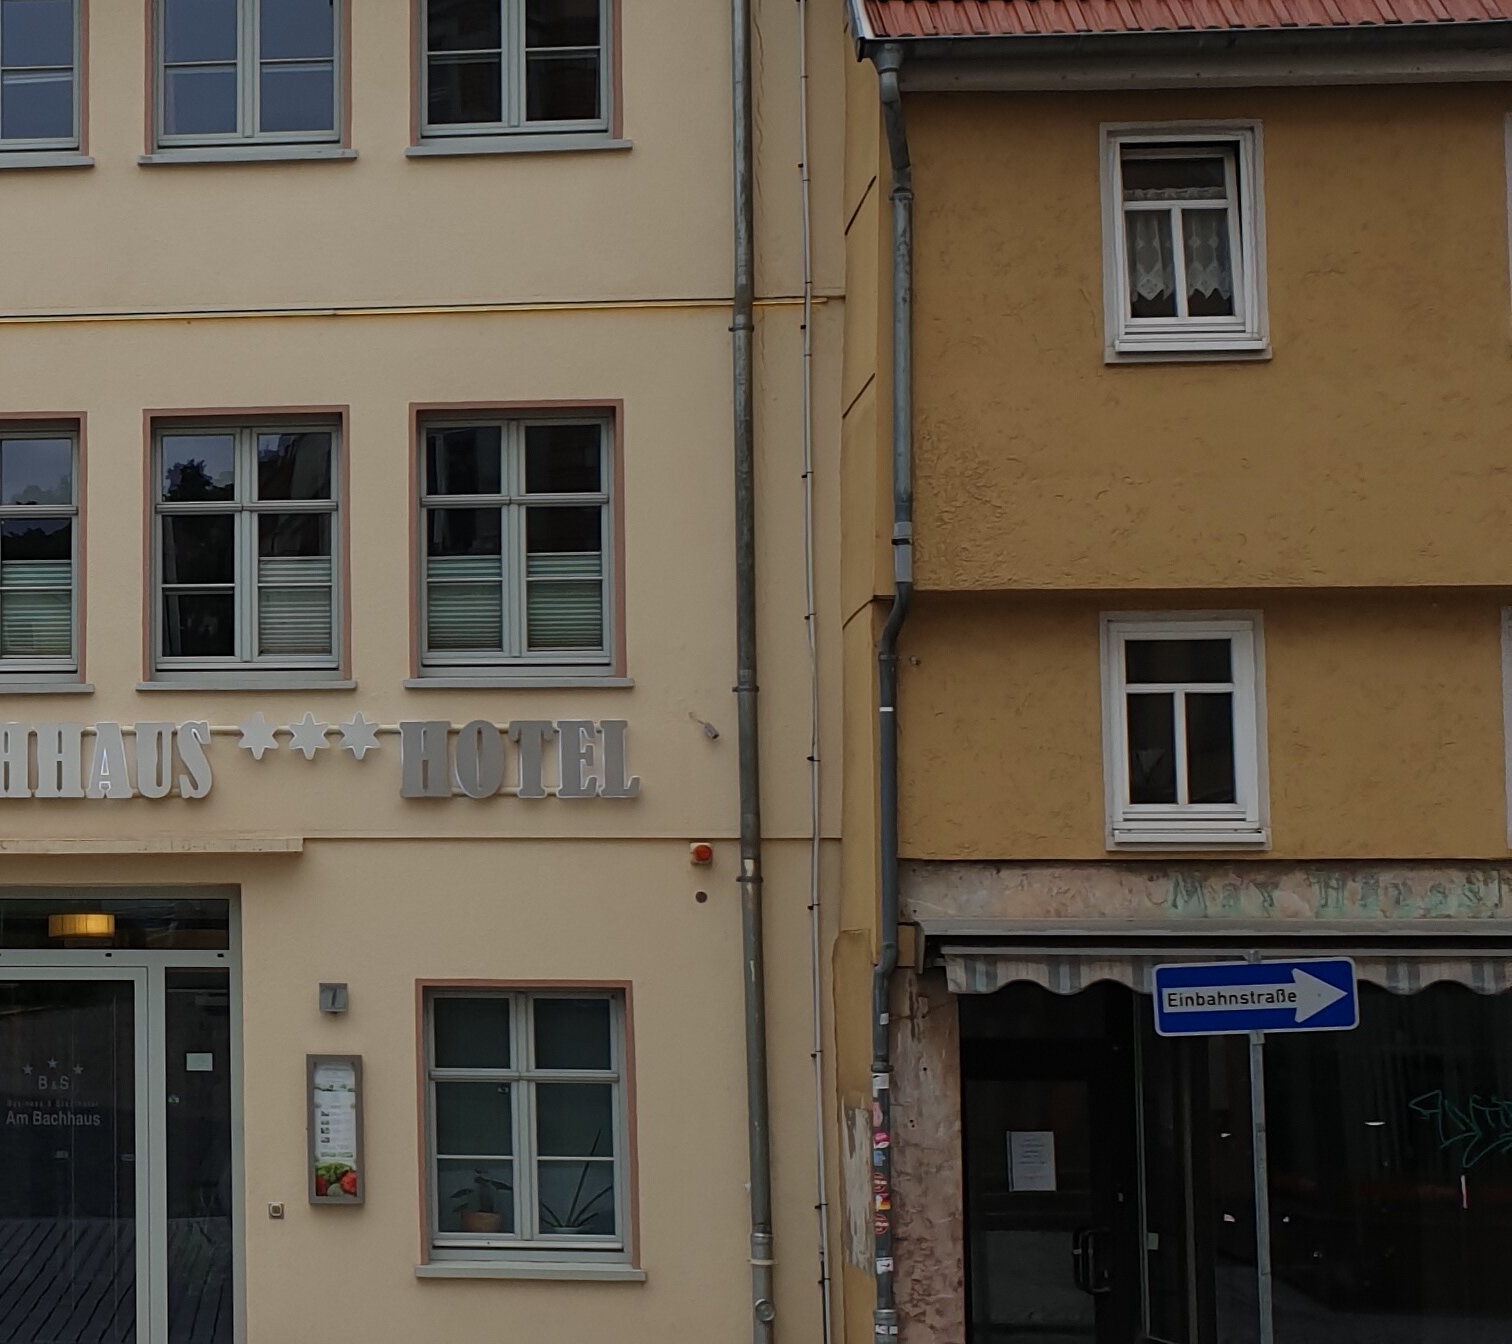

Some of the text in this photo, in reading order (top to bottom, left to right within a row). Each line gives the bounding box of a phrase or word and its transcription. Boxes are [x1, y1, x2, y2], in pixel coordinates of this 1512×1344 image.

[398, 718, 642, 801] HOTEL
[1166, 989, 1298, 1008] Einbahnstraße
[5, 1110, 101, 1126] Am Bachhaus
